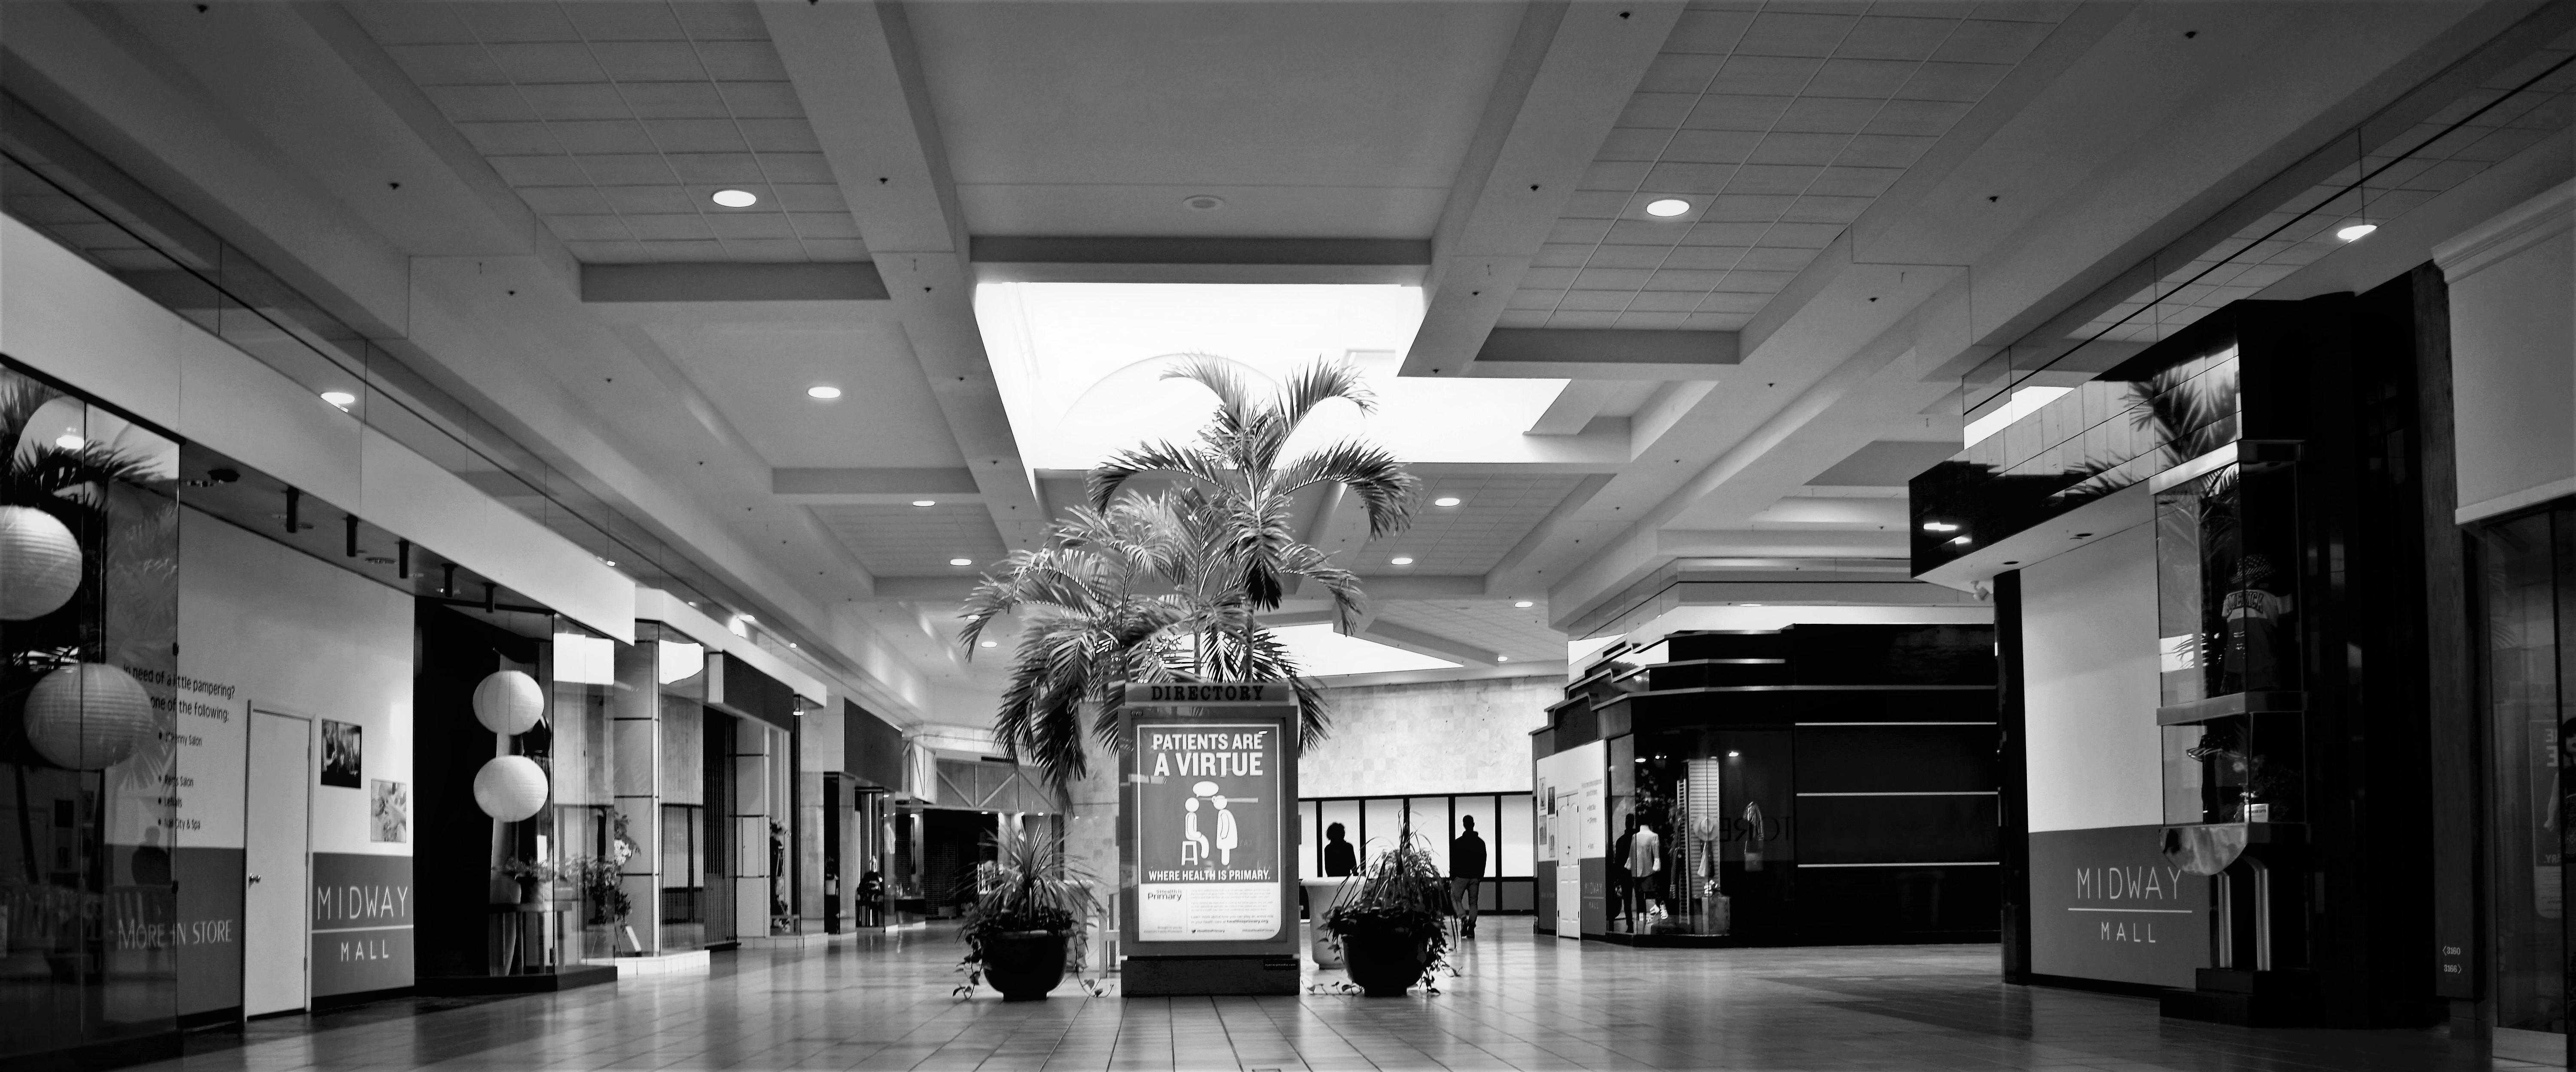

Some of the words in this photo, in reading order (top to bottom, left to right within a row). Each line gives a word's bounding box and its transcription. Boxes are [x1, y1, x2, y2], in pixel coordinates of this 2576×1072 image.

[133, 667, 153, 682] need
[156, 671, 164, 684] of
[167, 676, 172, 686] a
[193, 680, 235, 700] pampering?
[1151, 686, 1264, 700] DIRECTORY
[167, 698, 176, 712] of
[179, 700, 192, 715] the
[194, 702, 229, 723] following:
[189, 735, 202, 746] Salon
[1153, 733, 1228, 750] PATIENTS
[1232, 733, 1263, 750] ARE
[1154, 752, 1170, 777] A
[1175, 752, 1263, 777] VIRTUE
[180, 776, 194, 787] Salon
[186, 819, 190, 829] &
[191, 818, 200, 831] Spa
[1148, 870, 1180, 881] WHERE
[1182, 870, 1215, 881] HEALTH
[1218, 870, 1227, 880] IS
[1229, 870, 1271, 880] PRIMARY.
[2077, 866, 2181, 899] MIDWAY
[317, 885, 408, 920] MIDWAY
[1148, 892, 1182, 902] Primary
[118, 918, 165, 950] MORE
[172, 922, 186, 946] IN
[193, 919, 233, 944] STORE
[2101, 921, 2156, 943] MALL
[341, 939, 389, 962] MALL
